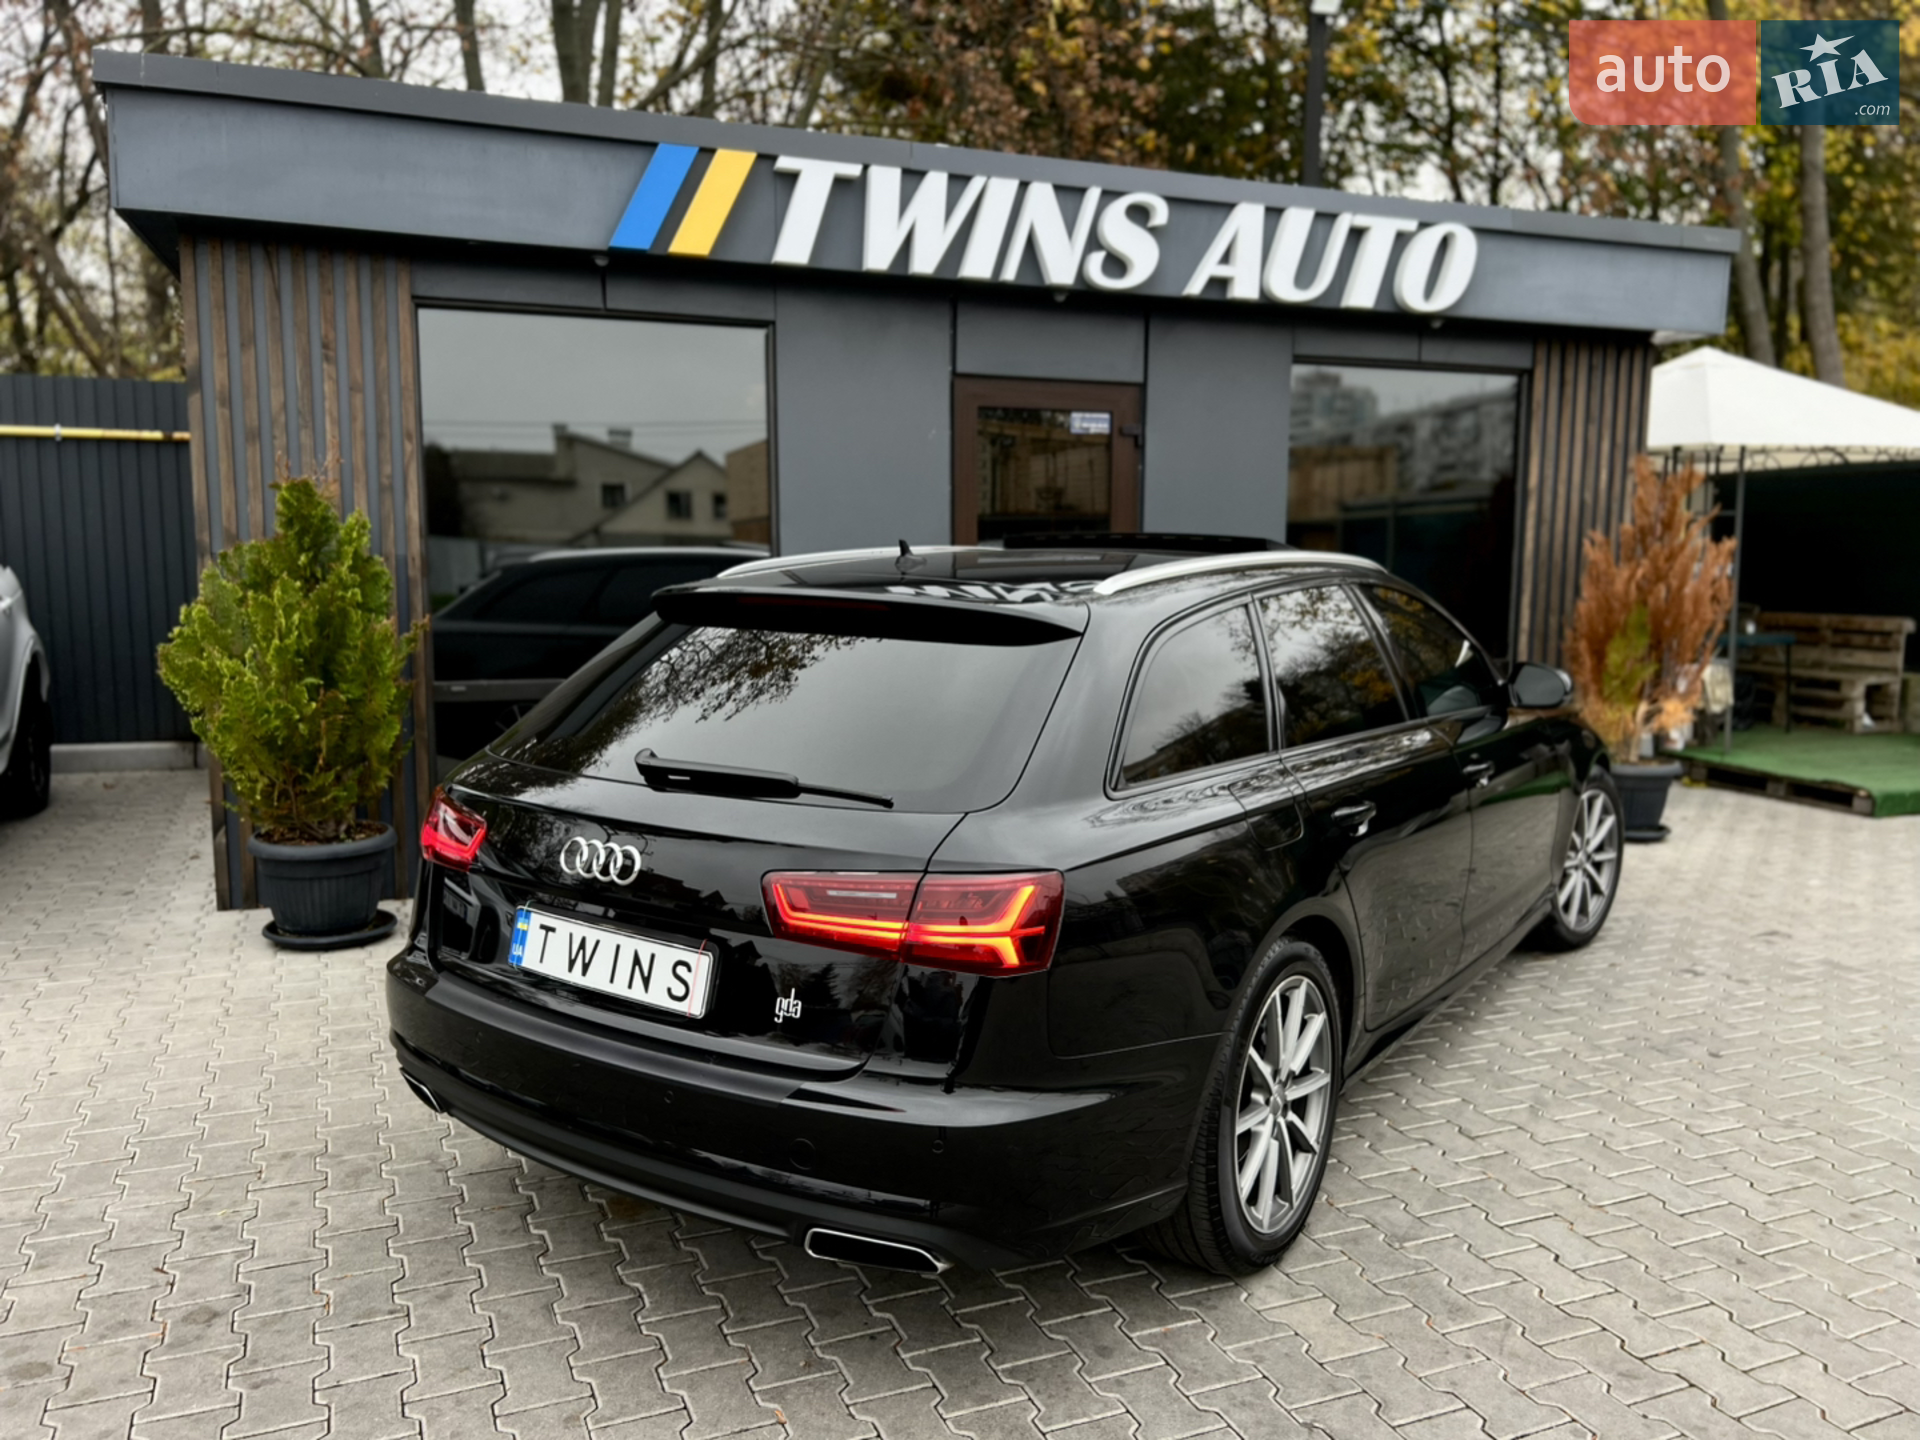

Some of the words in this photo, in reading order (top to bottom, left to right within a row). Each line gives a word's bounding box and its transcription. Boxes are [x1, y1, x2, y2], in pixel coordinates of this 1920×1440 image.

[771, 155, 1169, 290] TWINS
[1182, 201, 1478, 313] AUTO
[539, 923, 692, 1003] TWINS
